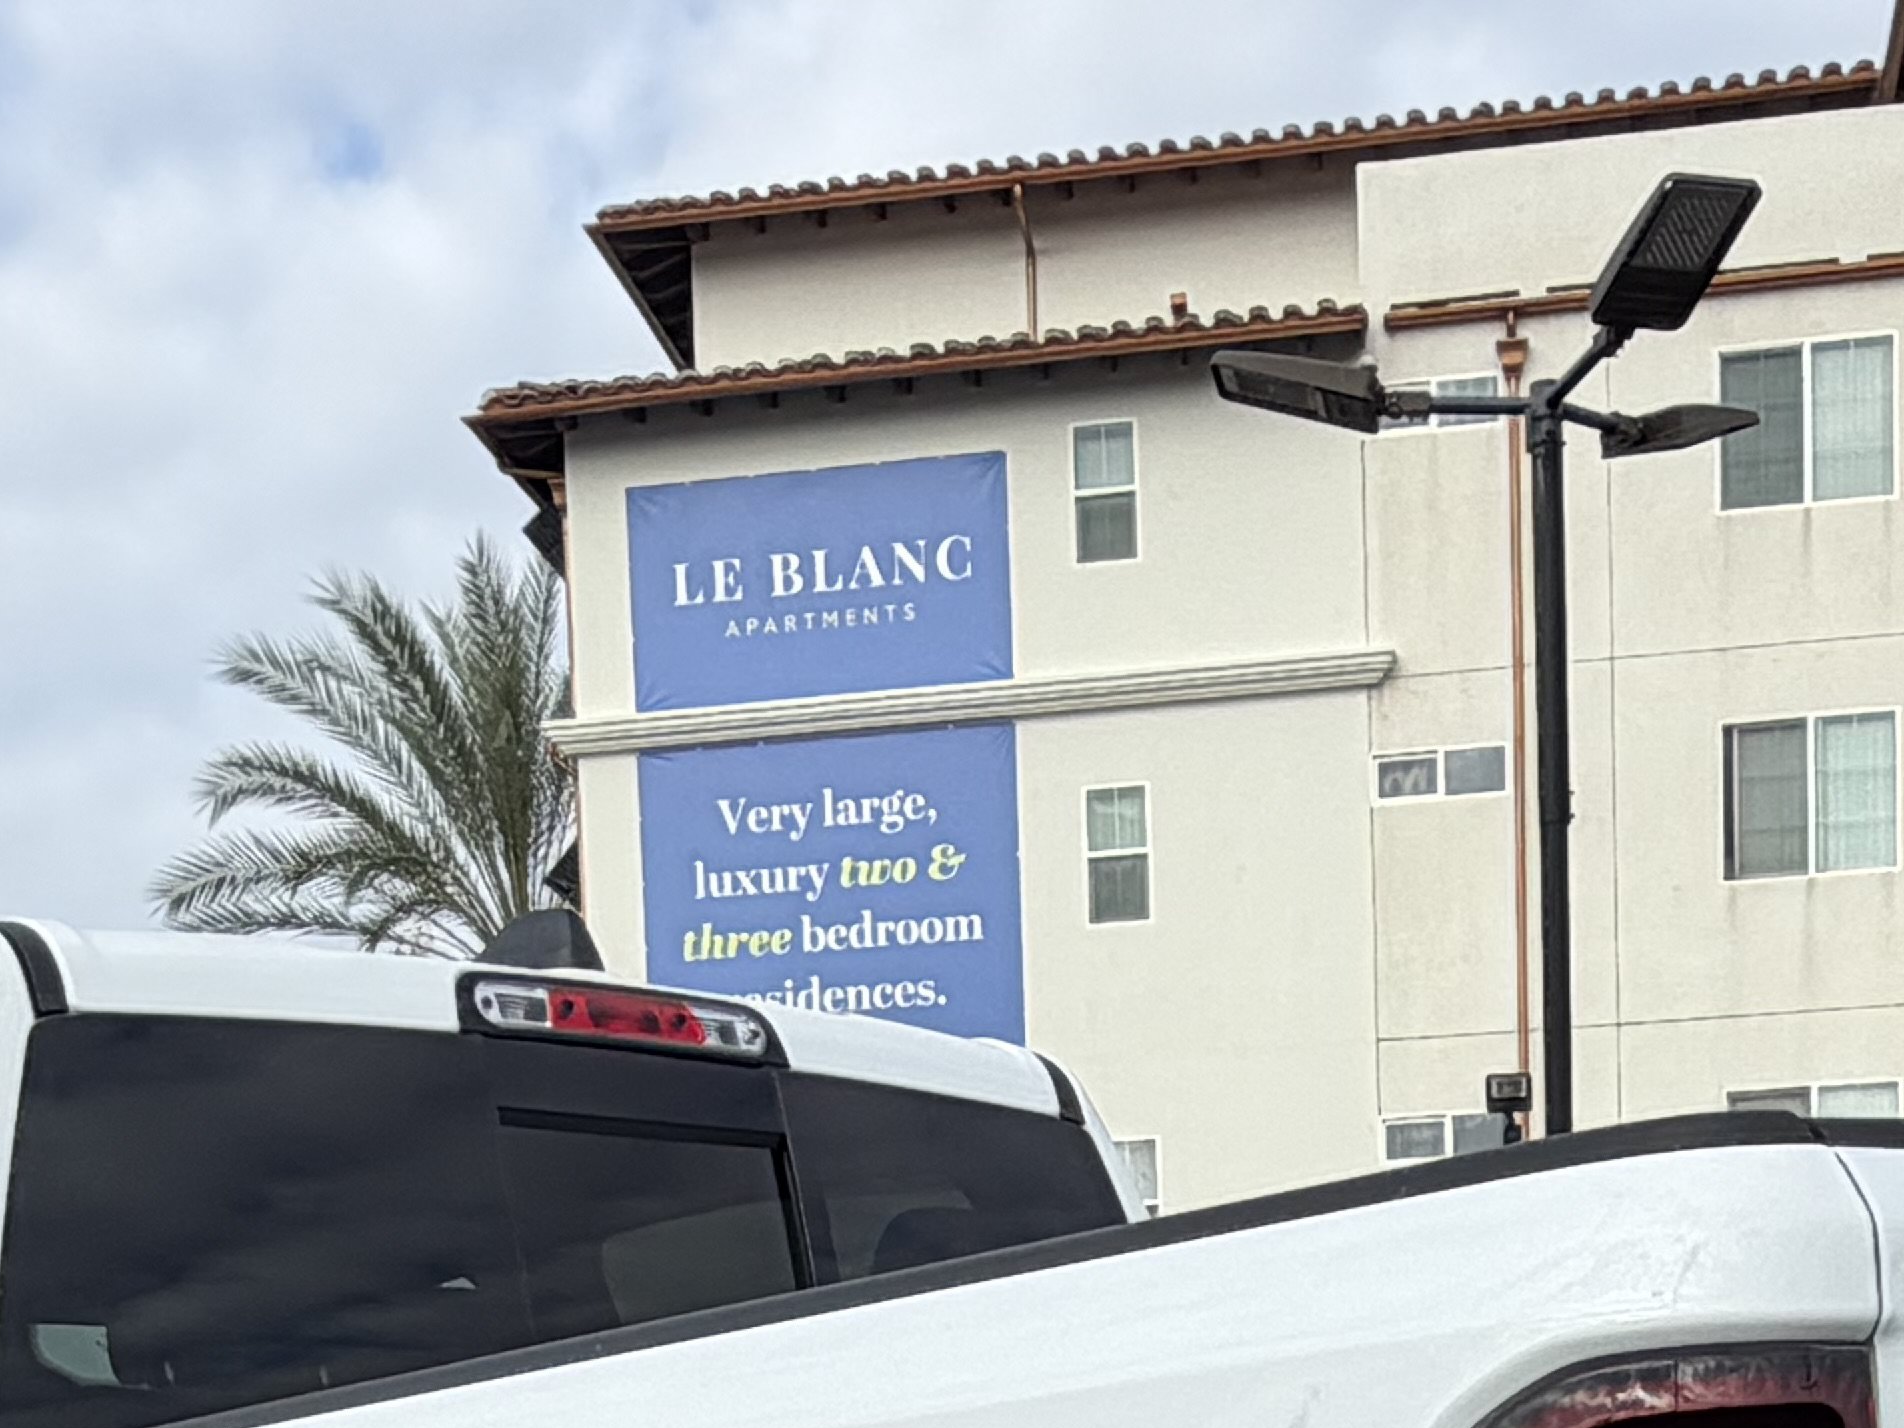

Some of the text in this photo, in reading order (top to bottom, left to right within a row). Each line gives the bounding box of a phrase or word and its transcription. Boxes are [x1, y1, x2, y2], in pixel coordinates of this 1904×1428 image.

[673, 534, 973, 607] LE BLANC
[724, 602, 917, 639] APARTMENTS
[715, 786, 938, 842] Very large,
[693, 842, 967, 902] luxury two &
[682, 908, 985, 962] three bedroom
